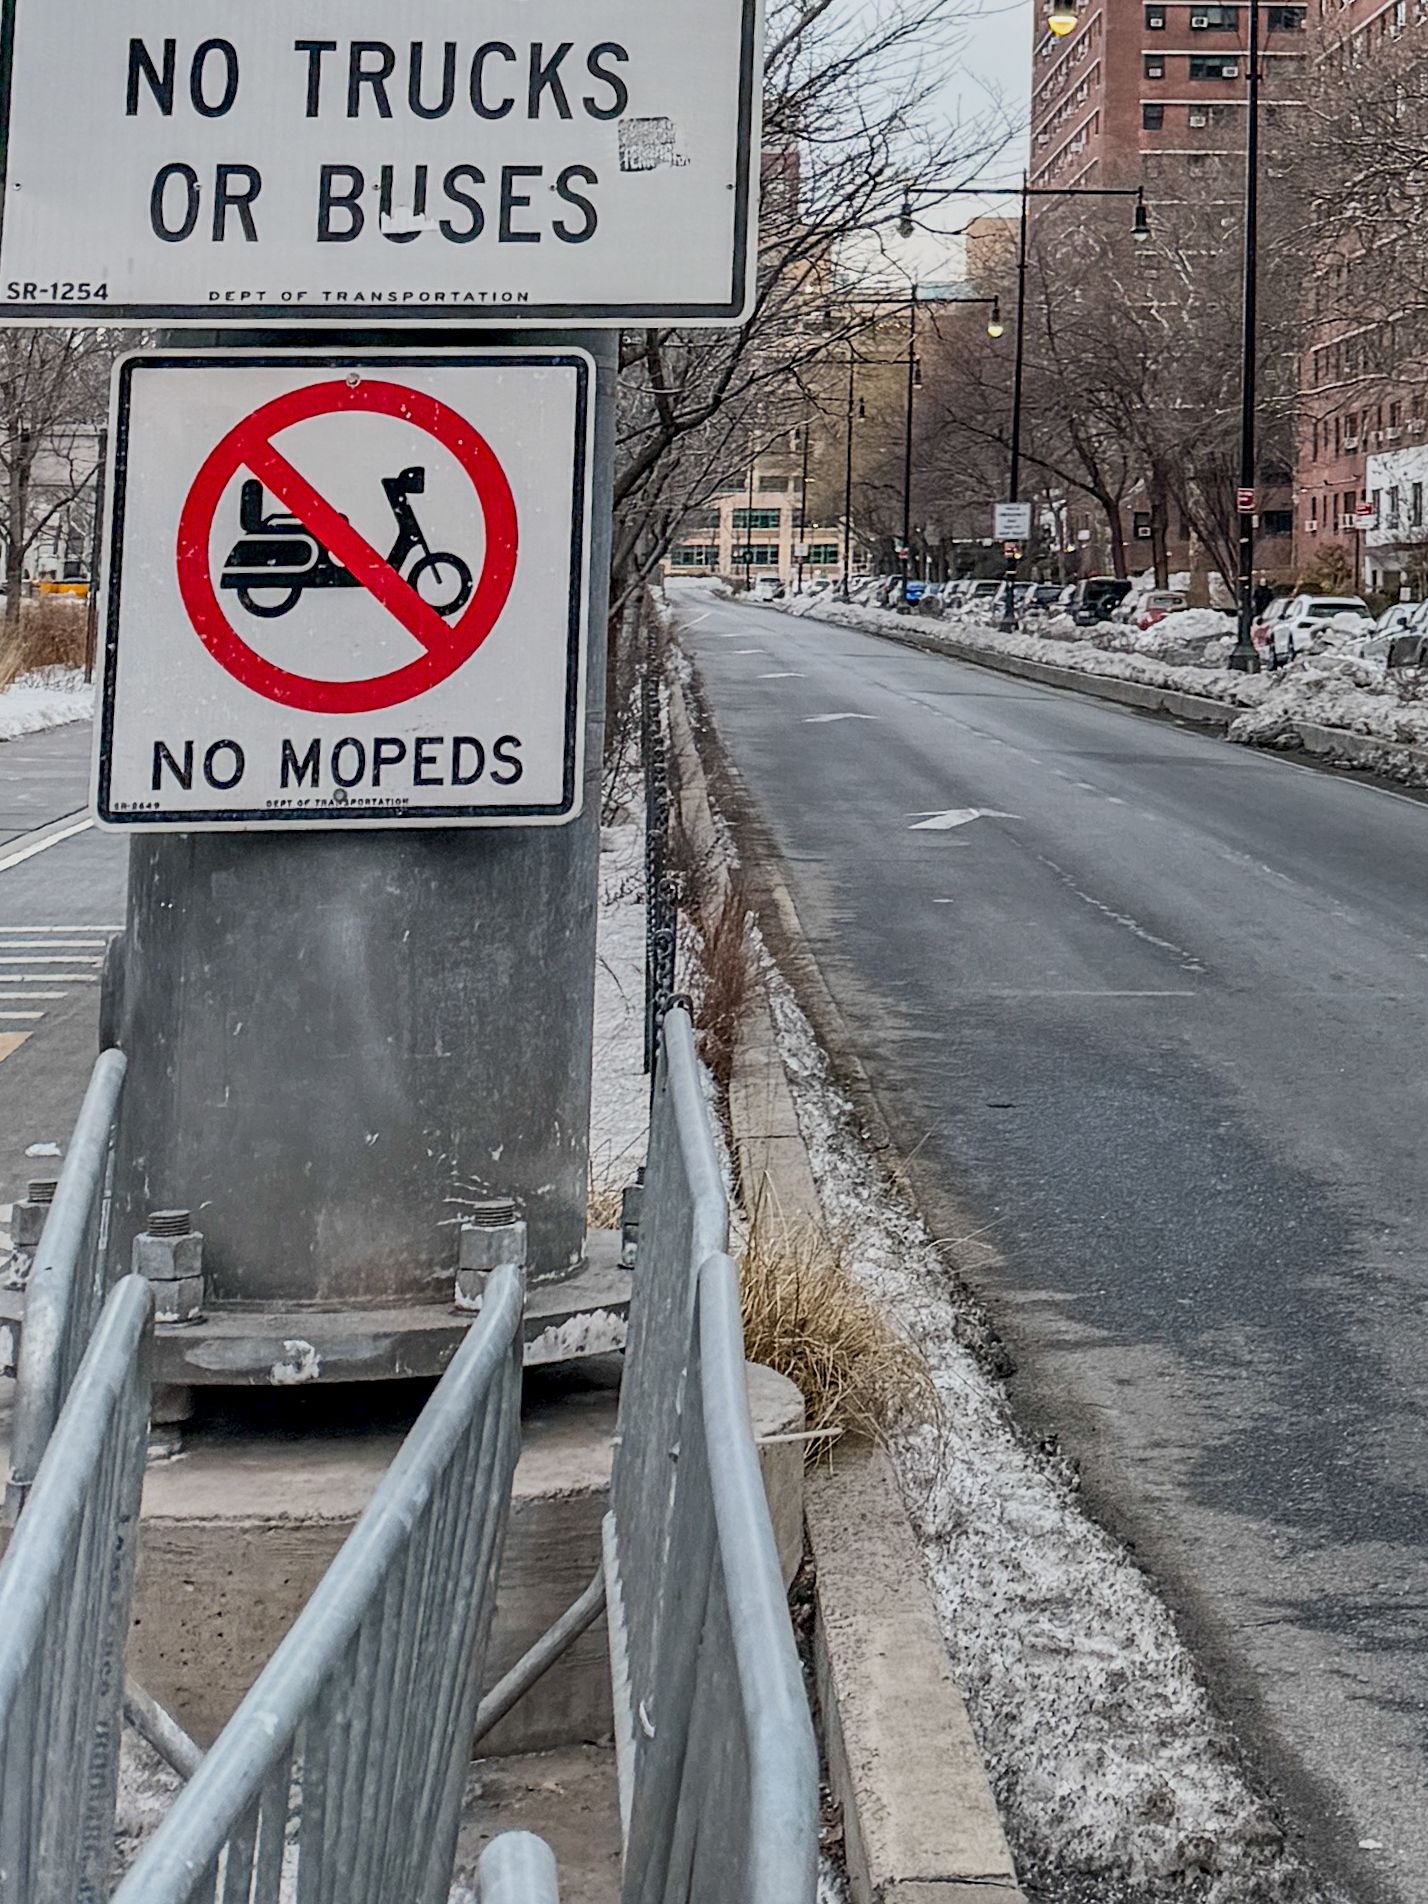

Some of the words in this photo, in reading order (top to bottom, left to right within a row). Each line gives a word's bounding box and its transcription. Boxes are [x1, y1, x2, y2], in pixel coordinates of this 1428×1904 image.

[126, 38, 238, 117] NO
[295, 40, 629, 120] TRUCKS
[151, 163, 261, 242] OR
[317, 164, 598, 243] BUSES
[6, 281, 109, 301] SR-1254
[208, 290, 267, 302] DEPT
[281, 290, 308, 301] OF
[322, 290, 530, 302] TRANSPORTATION
[152, 739, 245, 790] NO
[280, 735, 523, 788] MOPEDS
